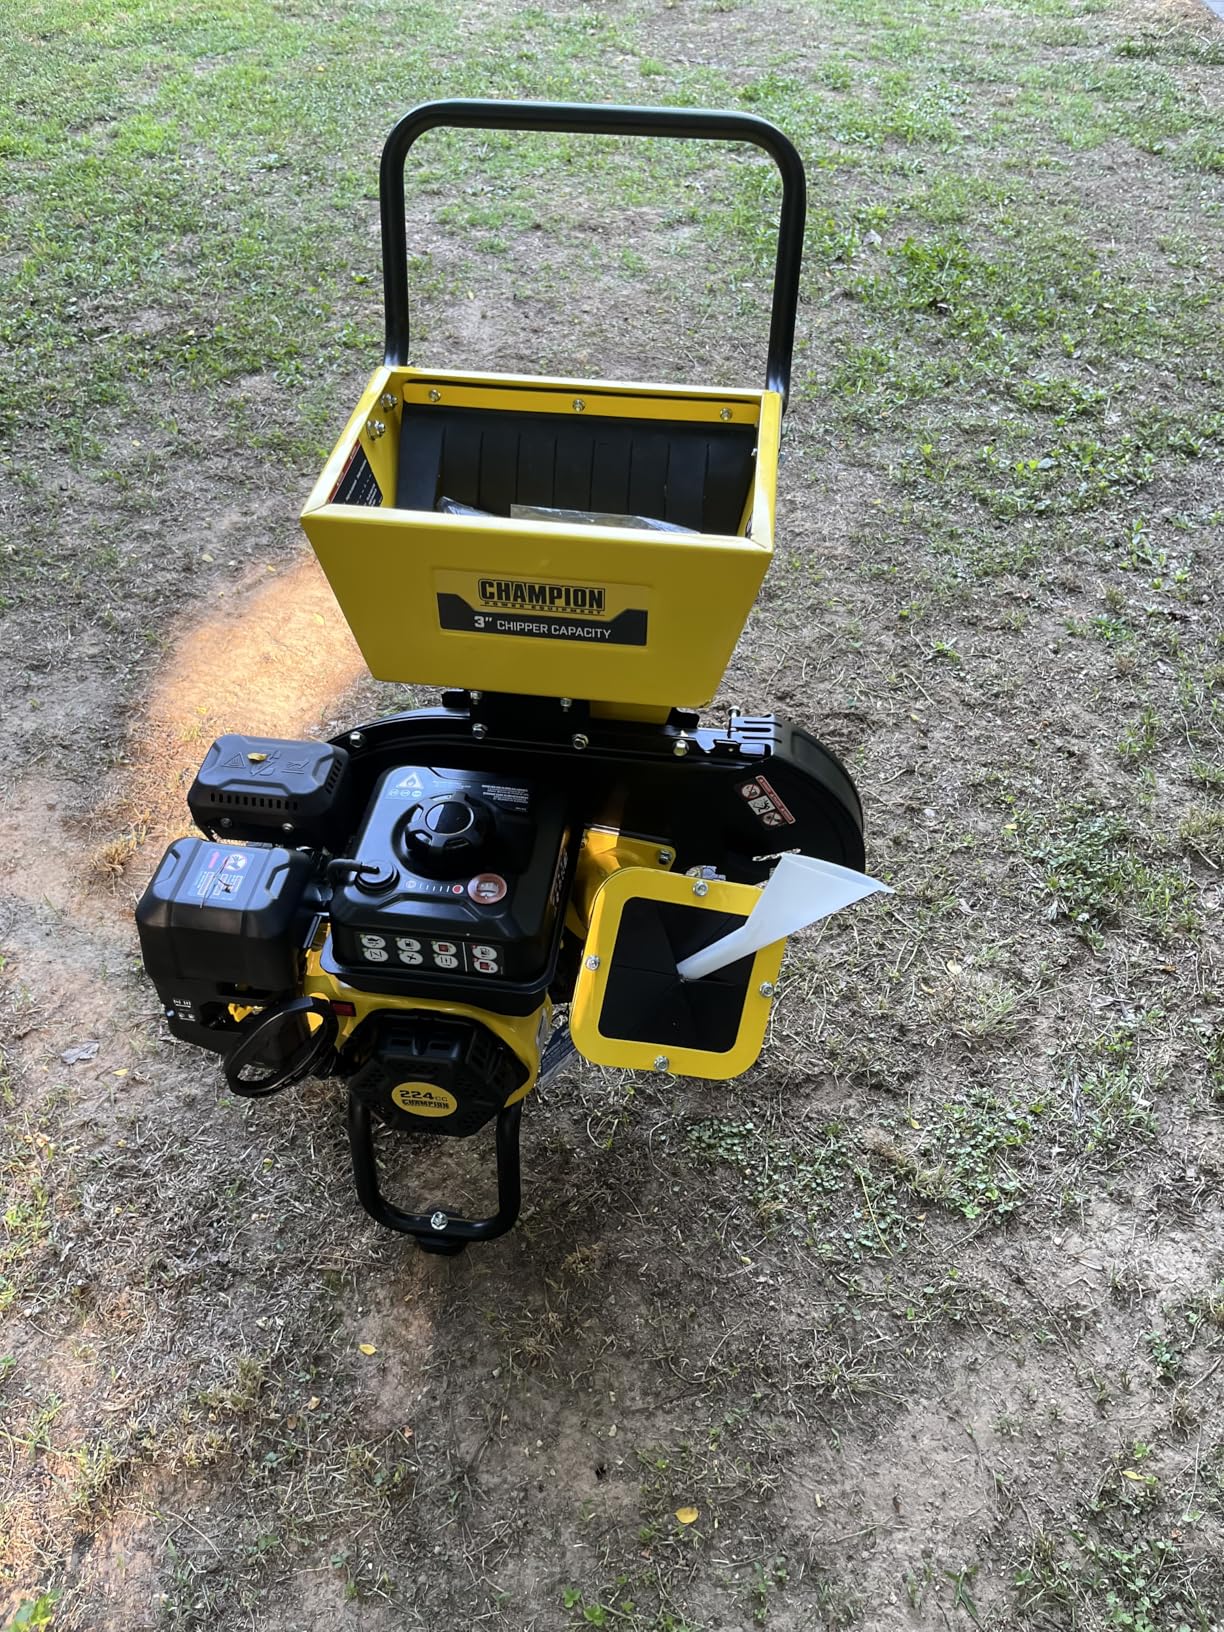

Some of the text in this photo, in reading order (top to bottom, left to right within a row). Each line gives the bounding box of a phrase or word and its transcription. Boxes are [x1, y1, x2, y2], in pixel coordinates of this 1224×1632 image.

[480, 580, 603, 609] CHAMPION
[497, 620, 548, 634] CHIPPER
[551, 625, 611, 639] CAPACITY
